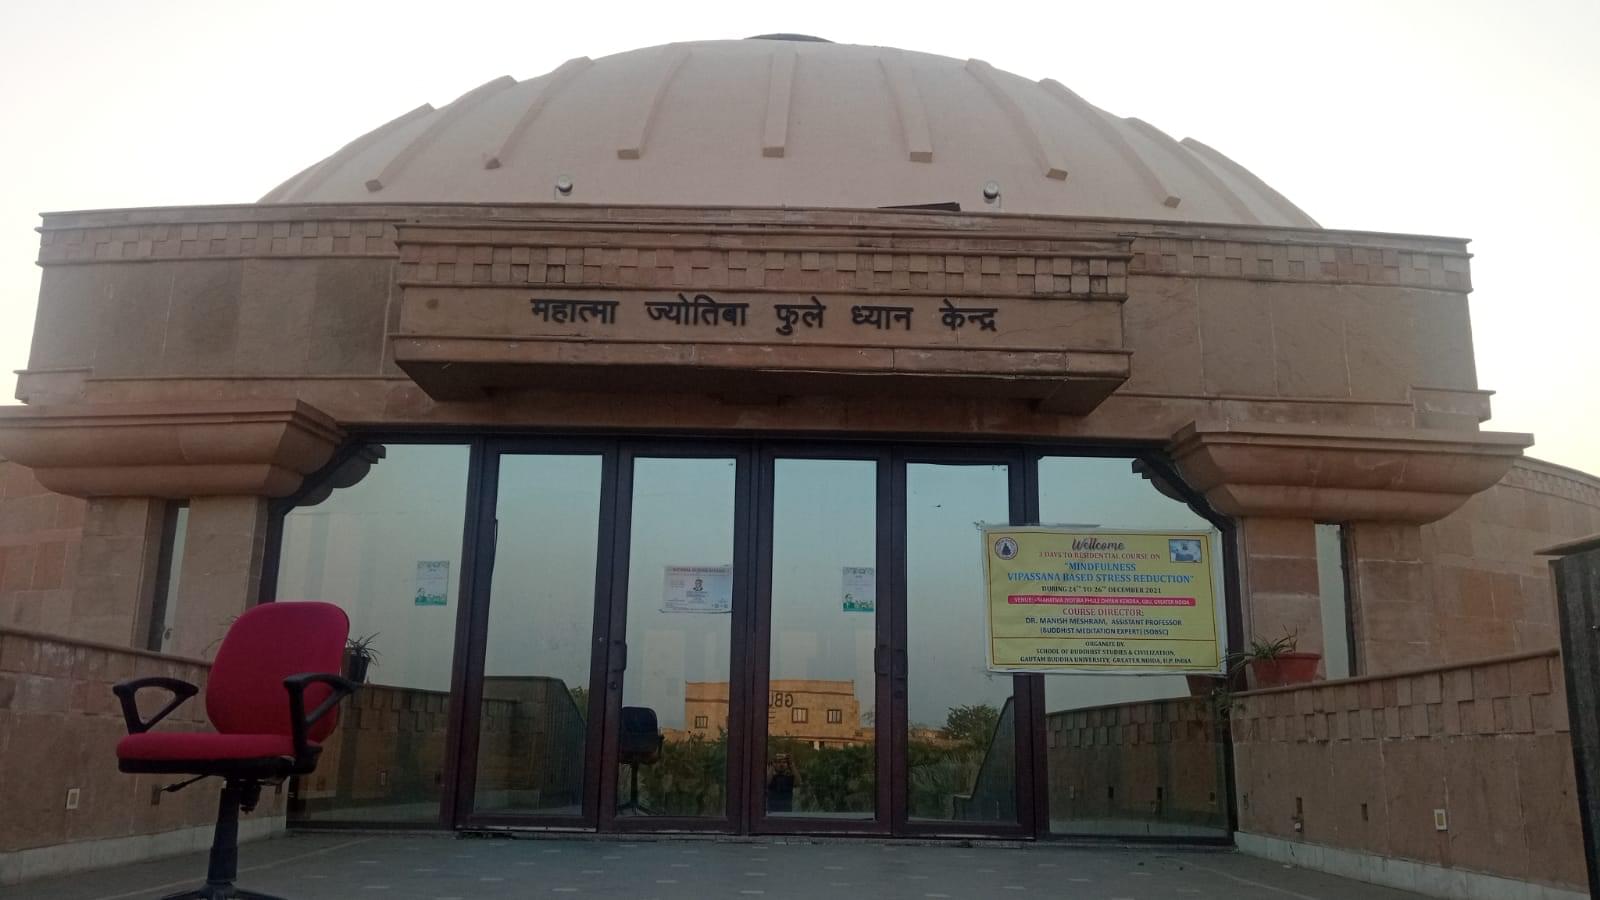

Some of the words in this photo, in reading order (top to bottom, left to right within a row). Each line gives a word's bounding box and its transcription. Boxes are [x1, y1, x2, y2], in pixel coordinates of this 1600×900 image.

[531, 299, 619, 324] महात्मा
[645, 293, 749, 326] ज्योतिबा
[774, 296, 826, 336] फुले
[851, 304, 914, 331] ध्यान
[939, 298, 998, 332] केन्द्र
[1071, 538, 1125, 551] Wellcome
[1074, 552, 1119, 560] RESIDENTIAL
[1007, 572, 1060, 581] VIPASSANA
[1062, 573, 1094, 582] BASED
[1096, 574, 1132, 583] STRESS
[1062, 608, 1096, 616] COURSE
[1097, 608, 1145, 617] DIRECTOR:
[1069, 618, 1108, 626] MESHRAM,
